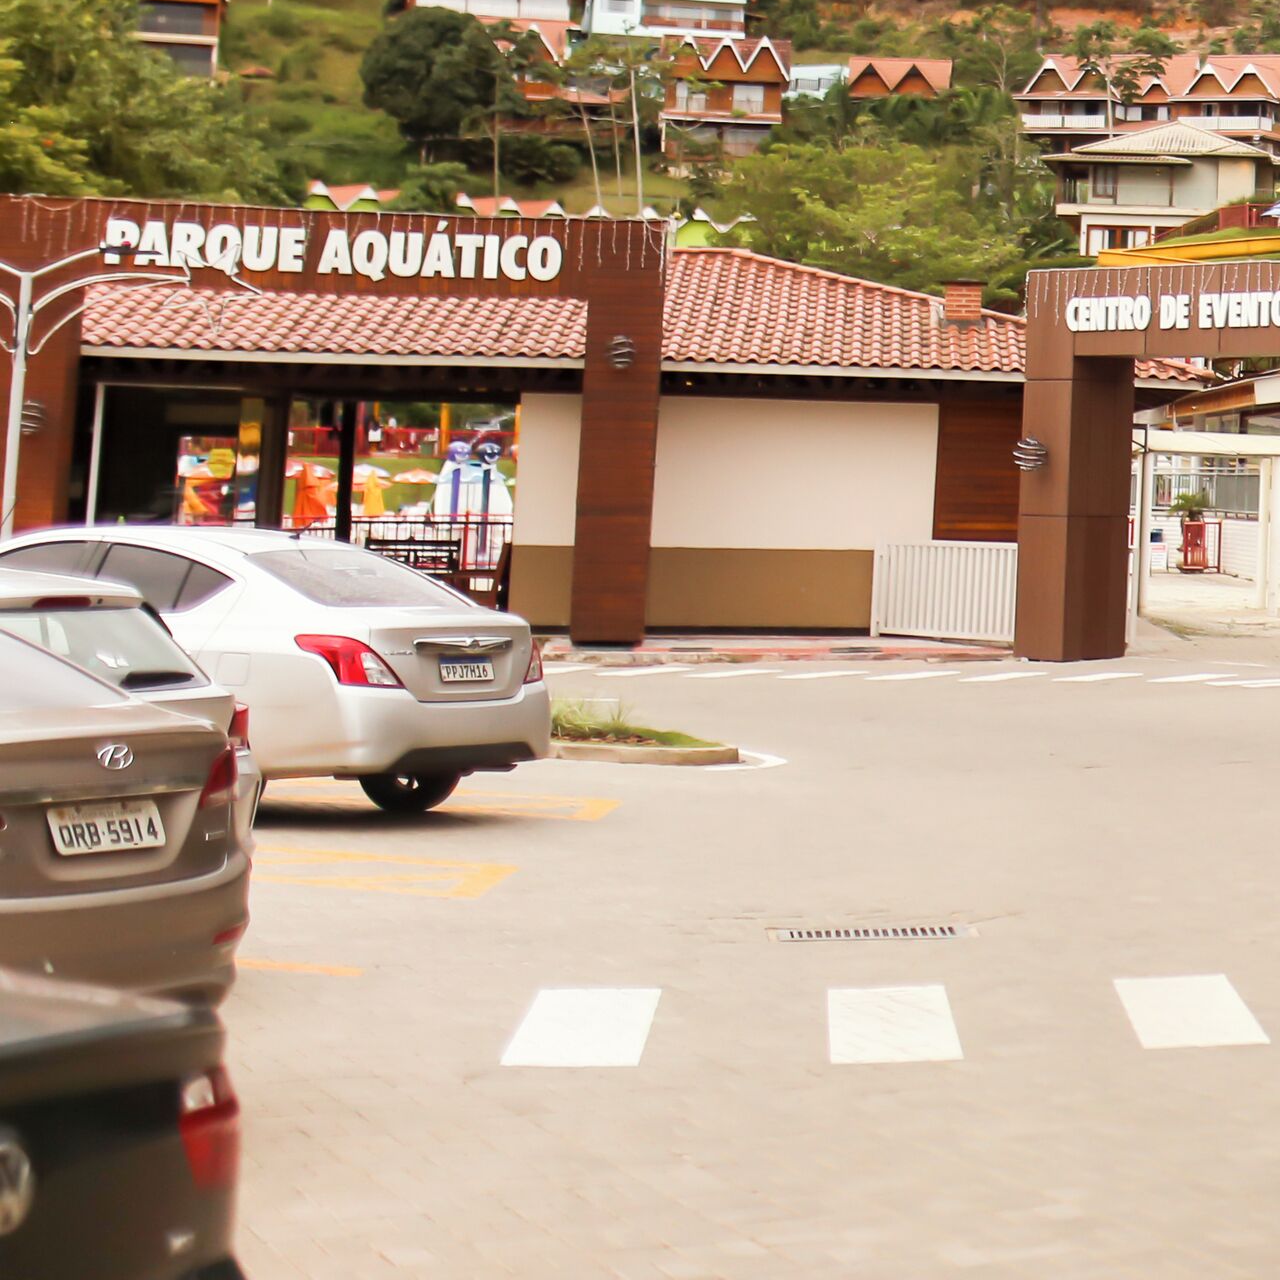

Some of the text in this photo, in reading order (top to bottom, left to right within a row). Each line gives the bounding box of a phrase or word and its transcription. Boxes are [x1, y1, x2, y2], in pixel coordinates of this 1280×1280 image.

[104, 219, 562, 282] PARQUE AQUÁTICO
[1066, 295, 1152, 332] CENTRO
[1159, 294, 1191, 330] DE
